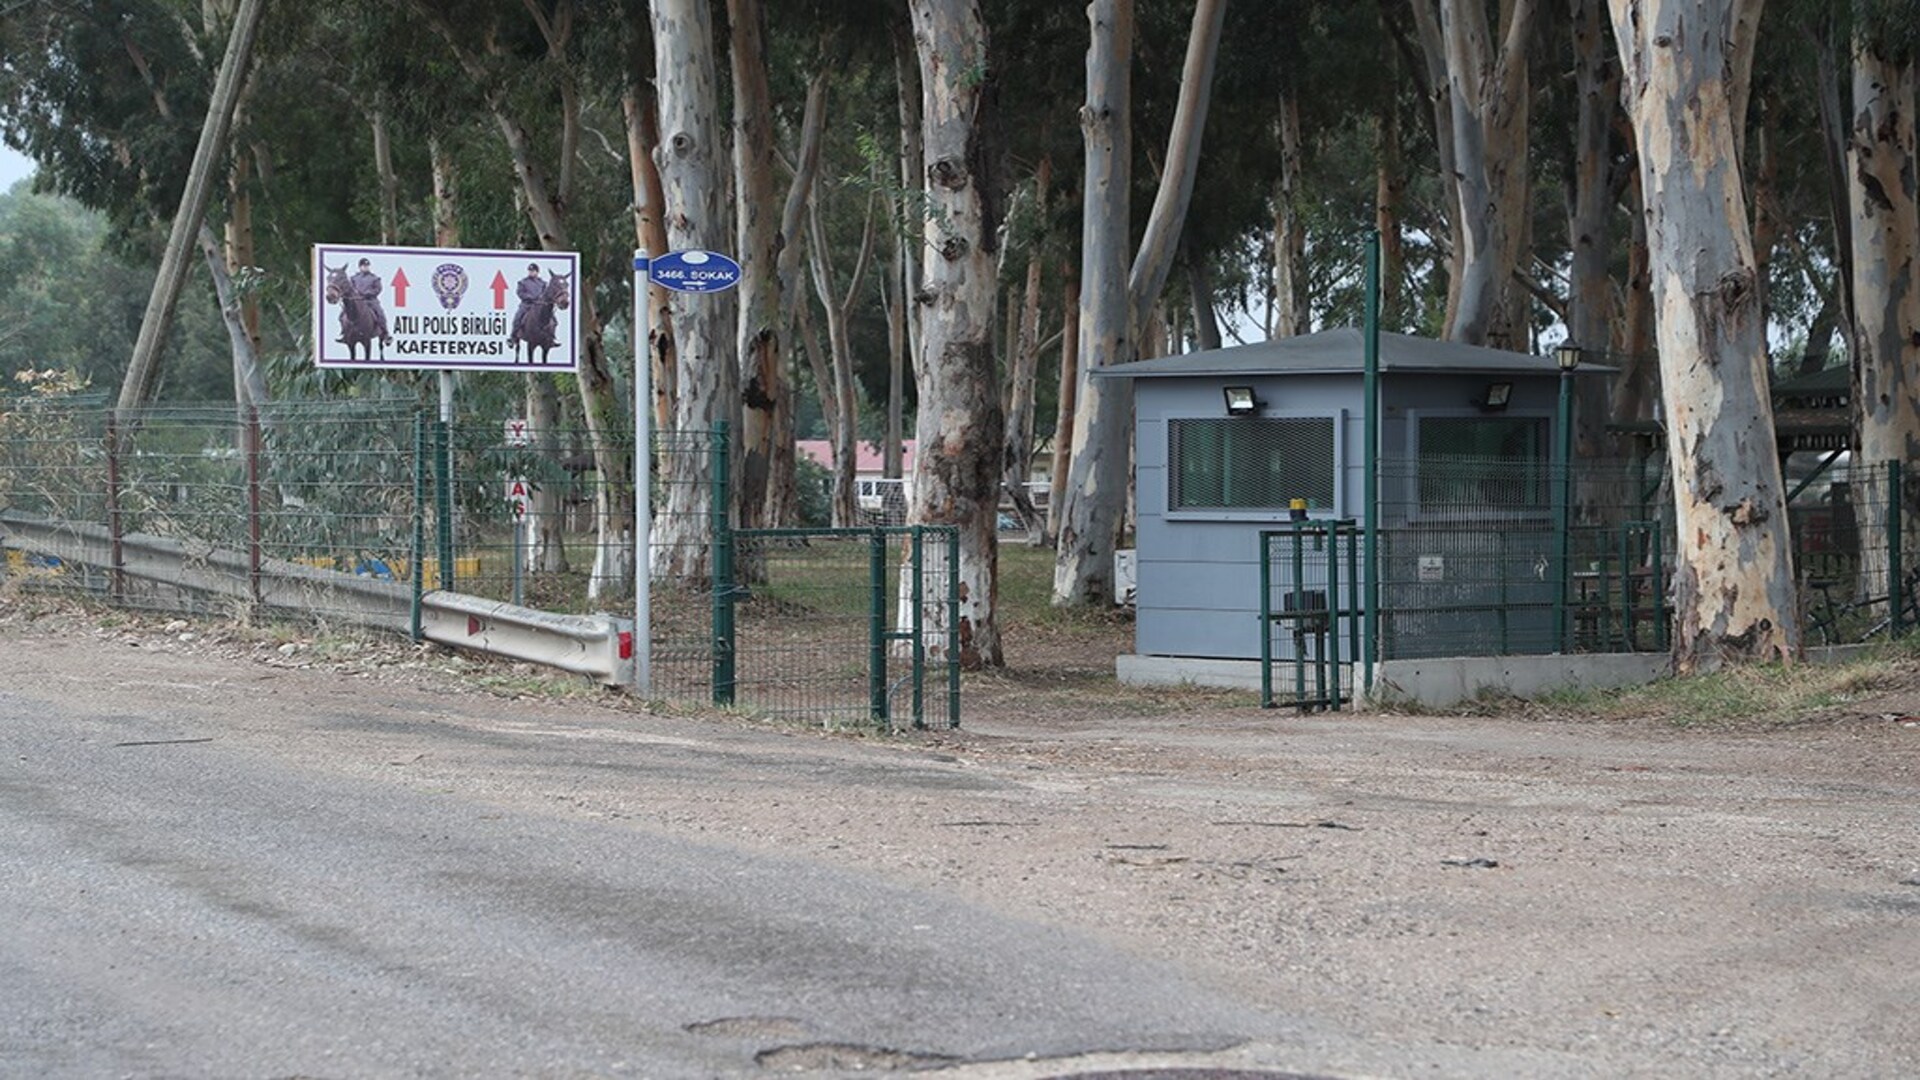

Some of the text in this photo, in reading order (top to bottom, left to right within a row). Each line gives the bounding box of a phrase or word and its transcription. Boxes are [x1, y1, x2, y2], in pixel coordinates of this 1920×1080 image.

[690, 271, 734, 280] SOKAK
[394, 311, 507, 335] ATLI POLİS BİRLİĞİ
[396, 340, 503, 355] KAFETERYASI
